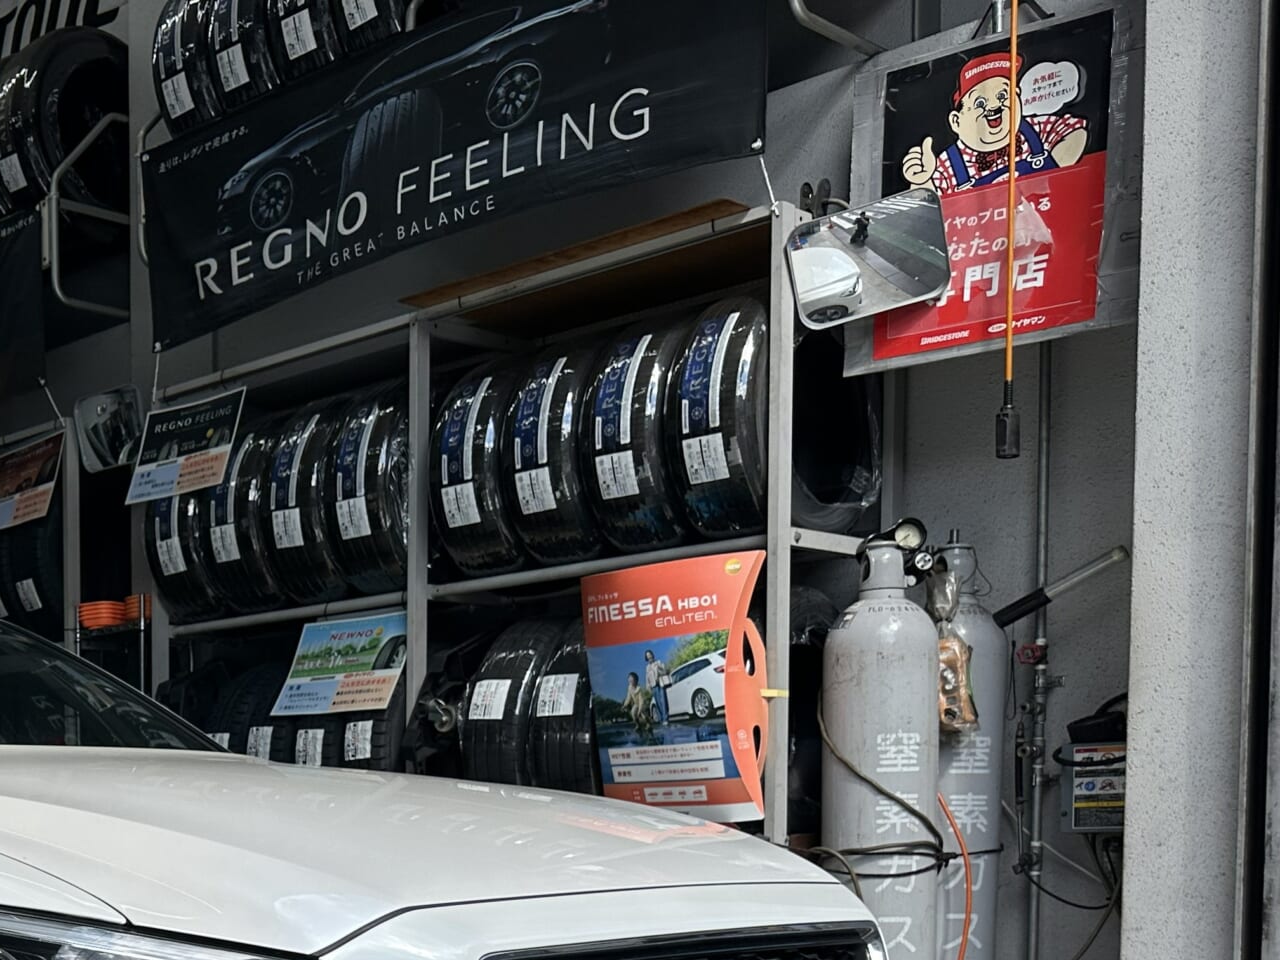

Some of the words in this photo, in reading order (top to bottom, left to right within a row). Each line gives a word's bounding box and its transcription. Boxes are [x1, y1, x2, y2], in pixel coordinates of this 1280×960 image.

[964, 60, 1018, 79] BRIDGESTO
[1032, 70, 1062, 85] お気軽に
[194, 190, 368, 299] REGNO
[396, 87, 651, 215] FEELING
[297, 261, 322, 284] THE
[330, 233, 384, 267] GREA
[396, 195, 496, 241] BALANCE
[937, 254, 1049, 306] 門店
[920, 329, 970, 346] BRIDGESTONE
[153, 418, 193, 434] REGNO
[194, 405, 233, 424] FEELING
[587, 595, 674, 624] FINESSA
[677, 594, 718, 611] HB01
[330, 628, 374, 642] NEWNO
